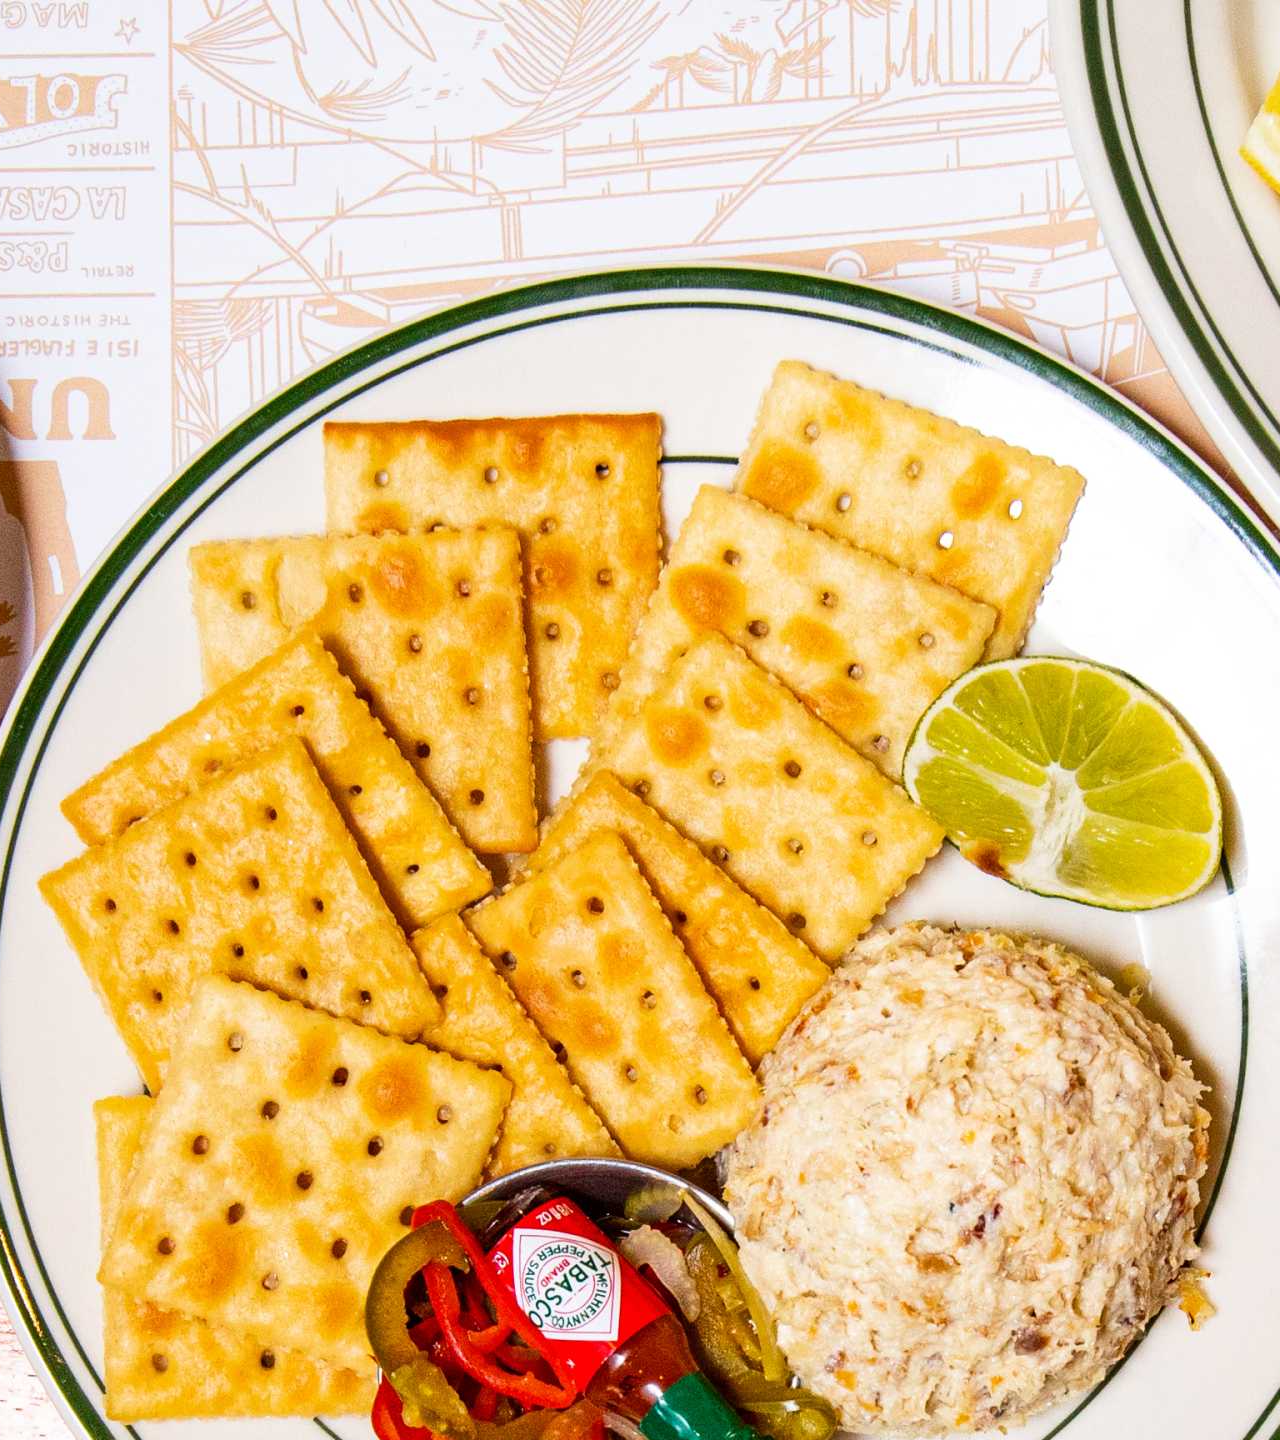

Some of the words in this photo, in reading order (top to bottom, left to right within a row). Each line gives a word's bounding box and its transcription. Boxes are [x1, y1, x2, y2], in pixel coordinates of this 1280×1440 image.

[66, 141, 150, 158] HISTORIC
[87, 187, 127, 220] LA
[80, 265, 135, 278] RETAIL
[6, 314, 92, 329] HISTORIC
[99, 314, 131, 327] THE
[87, 340, 98, 356] E
[535, 1211, 553, 1227] oz
[537, 1243, 586, 1261] PEPPER
[540, 1258, 571, 1288] BRAND
[524, 1260, 540, 1304] SAUCE
[528, 1250, 612, 1329] TABASCO
